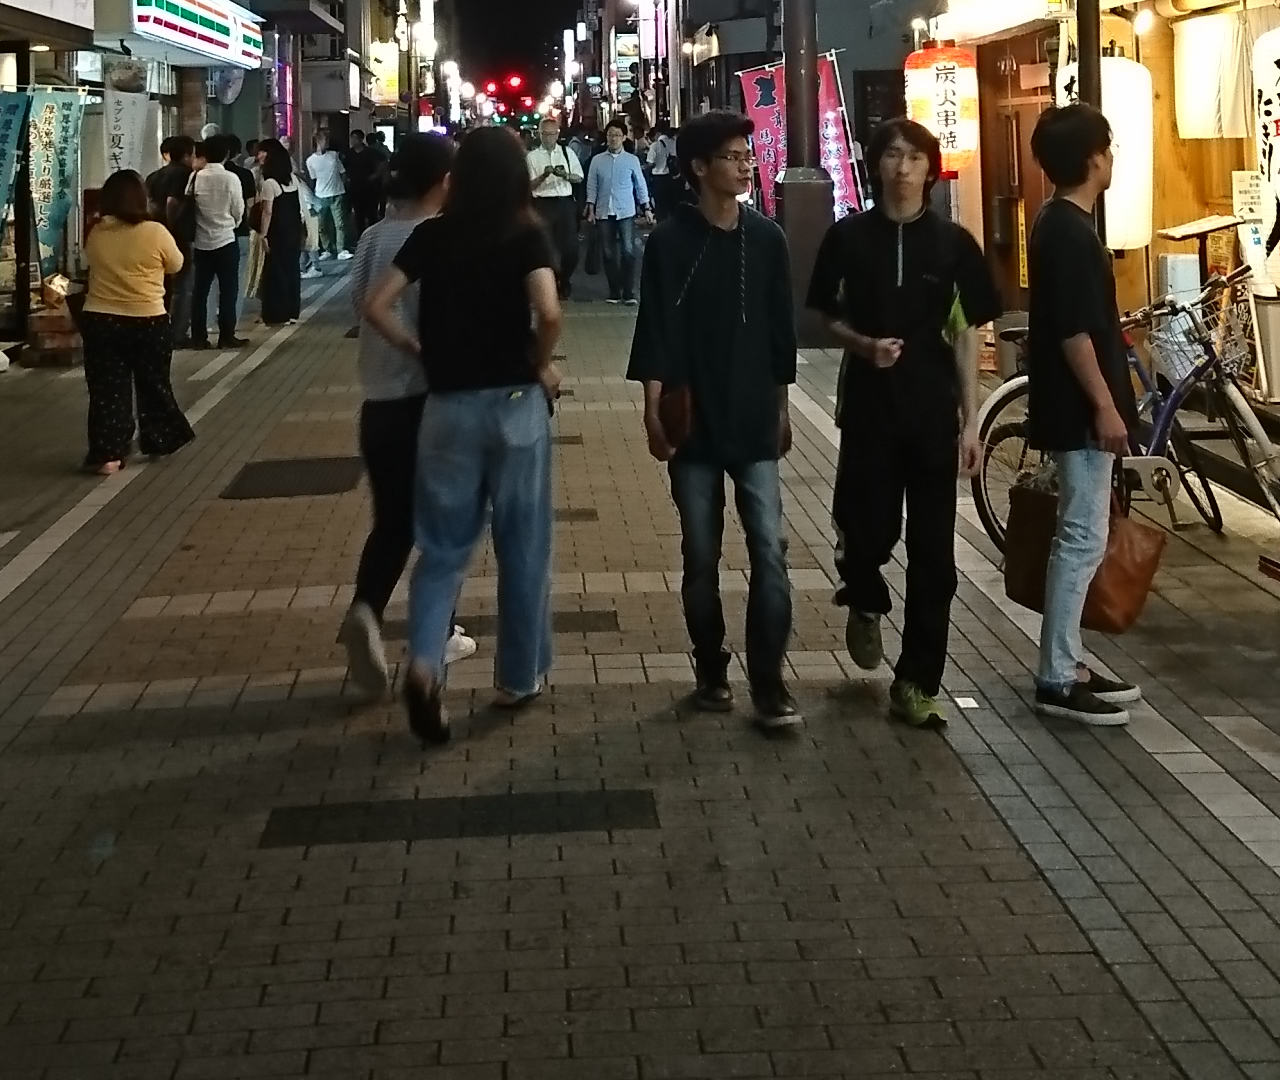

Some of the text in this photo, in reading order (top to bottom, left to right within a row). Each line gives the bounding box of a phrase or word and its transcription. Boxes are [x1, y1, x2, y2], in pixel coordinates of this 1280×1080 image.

[933, 63, 960, 150] 炭火串焼
[35, 103, 58, 230] 厚岸漁港より厳選した
